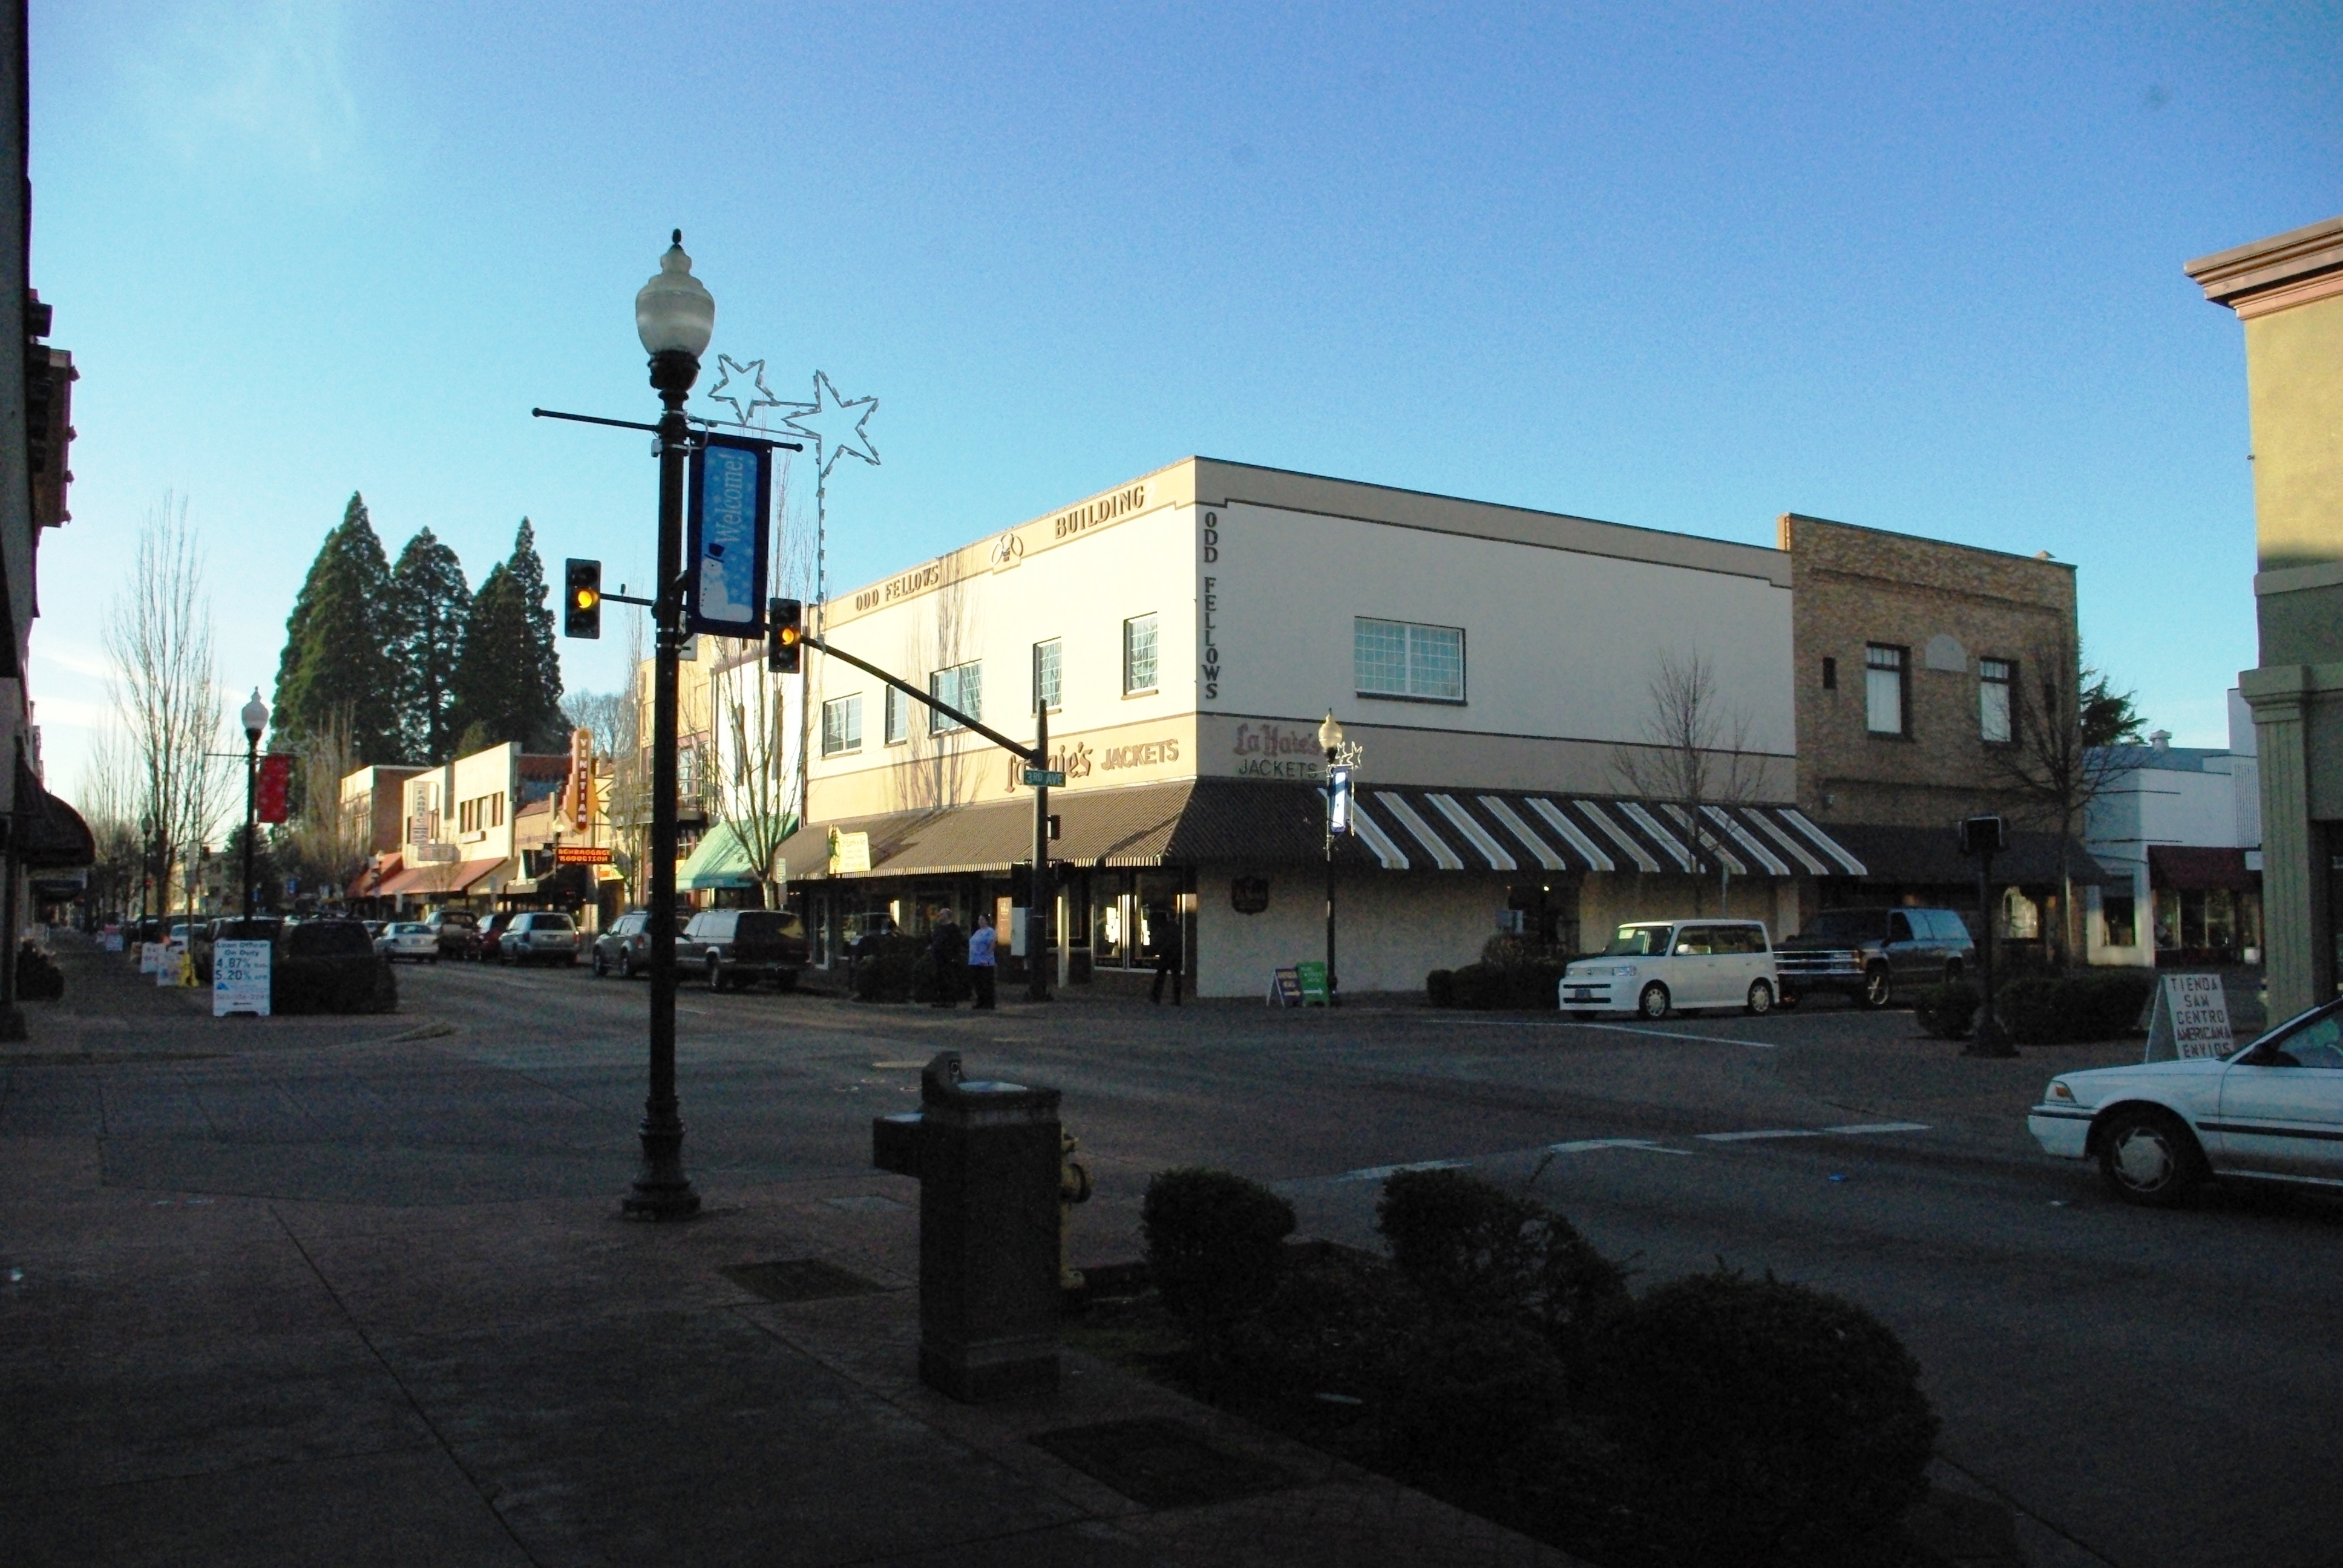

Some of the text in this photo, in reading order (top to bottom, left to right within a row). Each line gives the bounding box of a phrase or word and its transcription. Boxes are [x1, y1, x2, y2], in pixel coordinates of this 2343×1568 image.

[856, 485, 1145, 612] ODD FELLOWS BUILDING
[1201, 511, 1221, 700] ODD FELLOWS
[1101, 738, 1179, 771] JACKETS
[1026, 772, 1064, 785] 3RD AVE
[1238, 759, 1318, 779] JACKETS
[578, 738, 588, 823] VENETIAN
[2171, 977, 2218, 991] TIENDA
[2177, 1010, 2224, 1025] CENTRO
[2177, 1026, 2232, 1041] AMERICANA
[2182, 1041, 2231, 1059] ENVIOS
